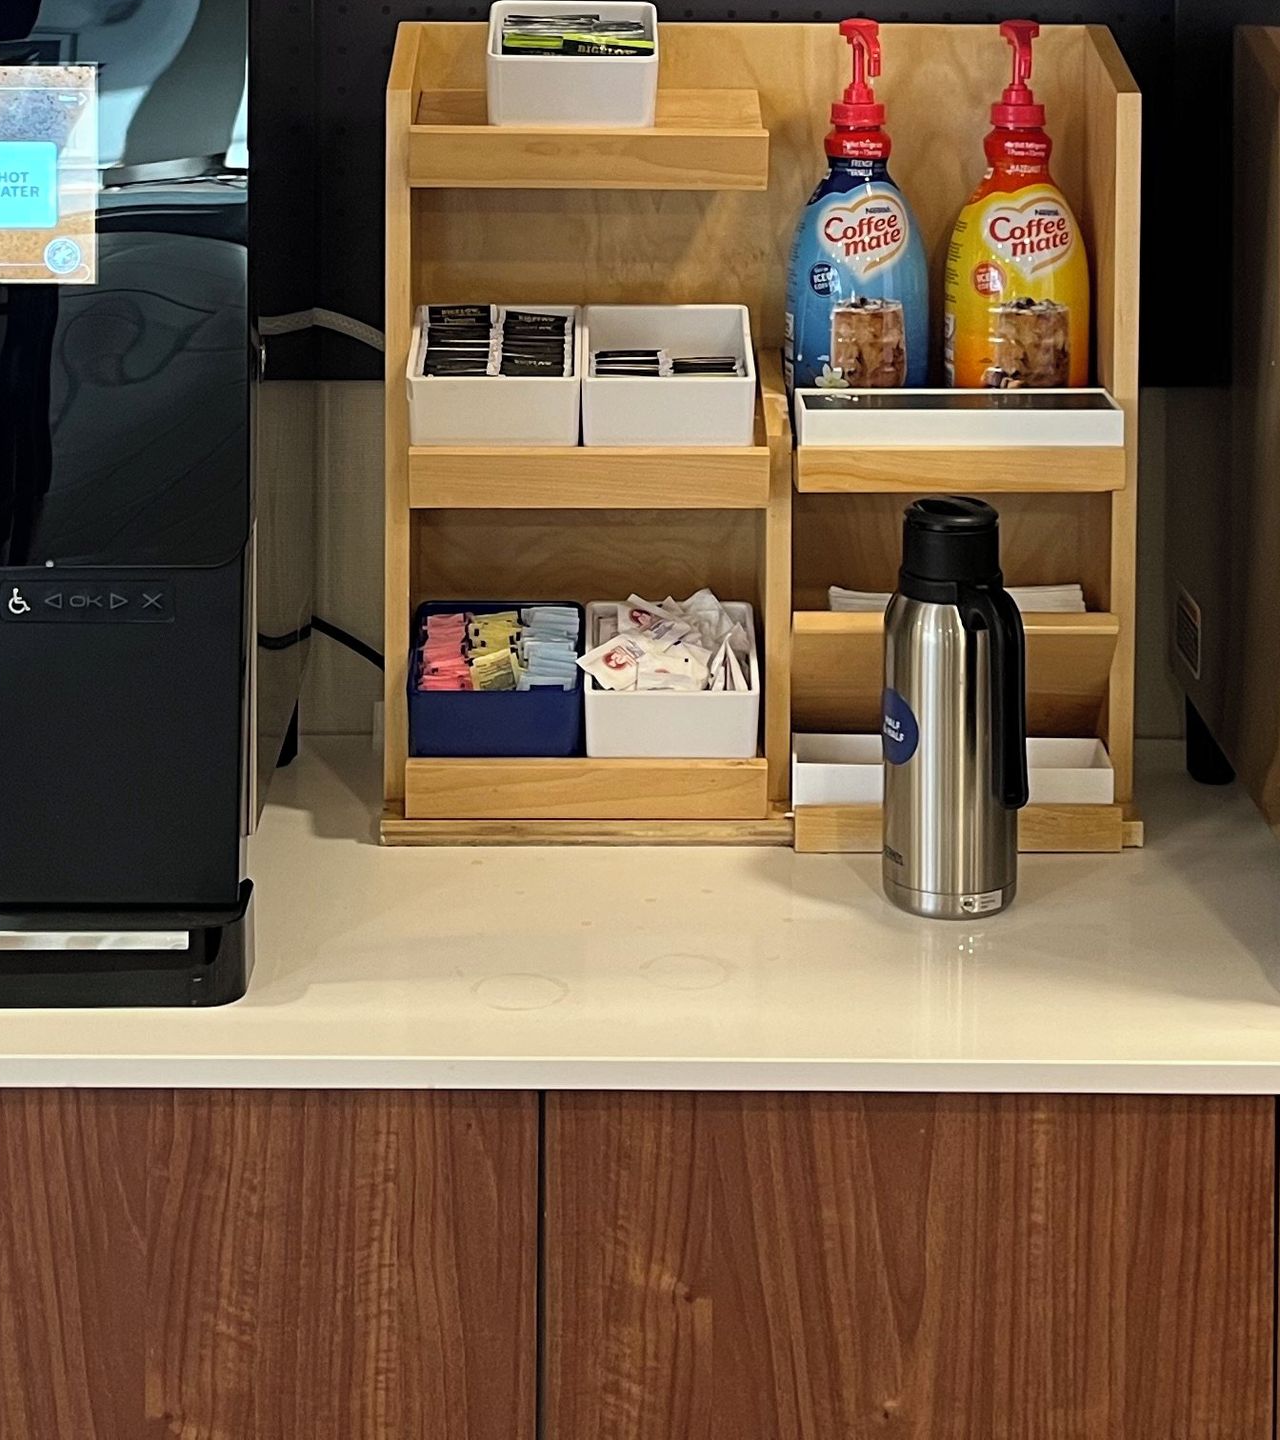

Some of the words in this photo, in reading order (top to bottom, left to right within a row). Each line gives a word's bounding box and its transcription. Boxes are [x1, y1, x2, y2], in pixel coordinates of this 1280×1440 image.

[824, 215, 898, 243] Coffee
[844, 227, 902, 257] mate
[989, 216, 1067, 243] Coffee
[1011, 231, 1070, 257] mate
[69, 594, 104, 608] OK
